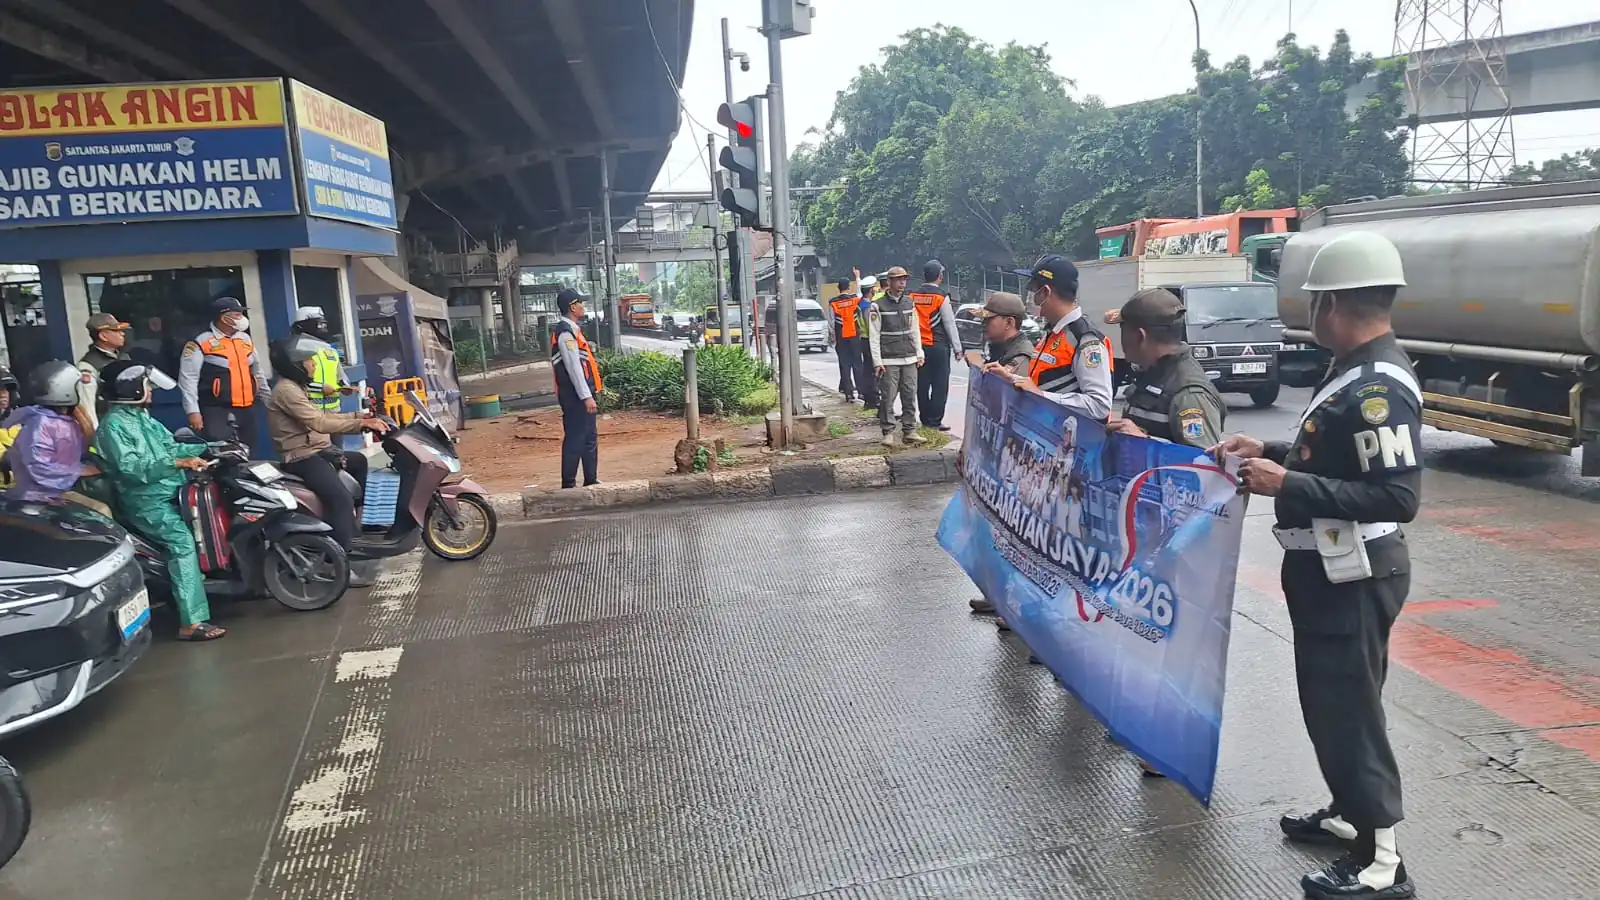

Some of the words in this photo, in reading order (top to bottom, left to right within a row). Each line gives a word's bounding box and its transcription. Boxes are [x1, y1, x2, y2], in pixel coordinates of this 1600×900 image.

[121, 85, 258, 125] ANGIN
[65, 145, 109, 156] SATLANTAS
[111, 143, 146, 154] JAKARTA
[146, 142, 172, 153] TIMUR
[0, 166, 51, 191] AJIB
[58, 160, 196, 189] GUNAKAN
[202, 157, 281, 182] HELM
[0, 194, 61, 220] SAAT
[69, 186, 263, 216] BERKENDARA
[1353, 424, 1417, 472] PM
